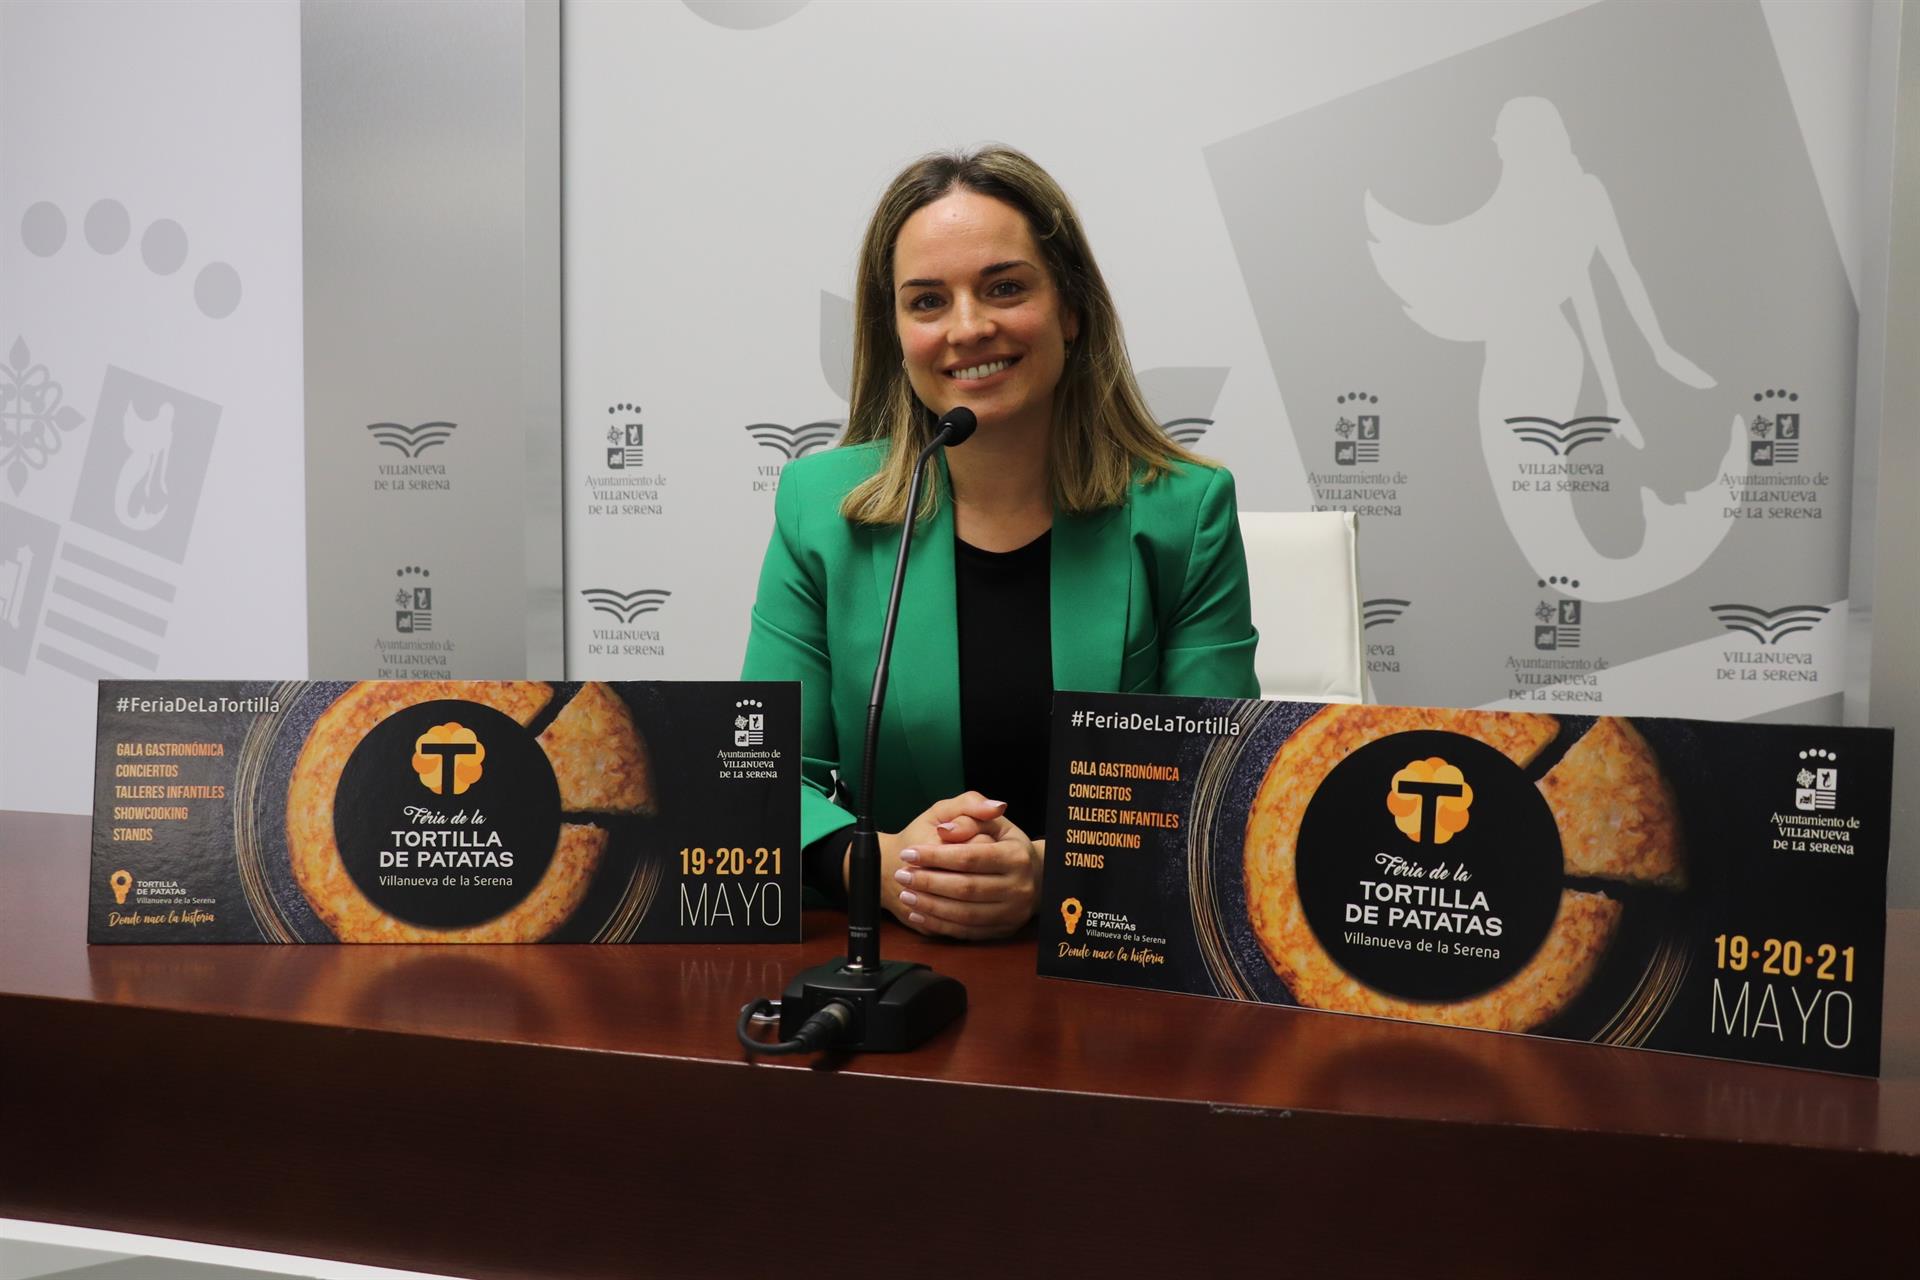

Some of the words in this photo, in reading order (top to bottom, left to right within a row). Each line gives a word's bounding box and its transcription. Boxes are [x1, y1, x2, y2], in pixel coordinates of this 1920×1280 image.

[585, 474, 653, 490] Ayuntamiento
[654, 473, 667, 486] de
[1307, 471, 1391, 488] Ayuntamiento
[1392, 470, 1409, 485] de
[1719, 472, 1810, 489] Ayuntamiento
[1812, 472, 1829, 486] de
[375, 638, 441, 652] Ayuntamiento
[443, 640, 456, 651] de
[1367, 660, 1400, 672] RENA
[1505, 655, 1591, 672] Ayuntamiento
[1593, 657, 1609, 670] de
[116, 697, 280, 713] #FeriaDeLaTortilla
[1071, 710, 1240, 736] #FeriaDeLaTortilla
[116, 743, 143, 756] GALA
[145, 741, 224, 756] GASTRONÓMICA
[717, 749, 770, 760] Ayuntamiento
[771, 749, 781, 758] de
[115, 764, 179, 778] CONCIERTOS
[1070, 760, 1097, 776] GALA
[1099, 762, 1180, 782] GASTRONÓMICA
[115, 785, 165, 799] TALLERES
[167, 785, 225, 799] INFANTILES
[1069, 783, 1132, 802] CONCIERTOS
[114, 806, 189, 820] SHOWCOOKING
[403, 805, 448, 825] Feria
[450, 809, 468, 825] de
[471, 809, 487, 825] la
[1067, 806, 1118, 824] TALLERES
[1119, 809, 1180, 829] INFANTILES
[1770, 812, 1844, 828] Ayuntamiento
[1846, 816, 1860, 829] de
[113, 828, 153, 841] STANDS
[391, 831, 503, 847] TORTILLA
[1066, 829, 1141, 849] SHOWCOOKING
[379, 851, 409, 868] DE
[417, 851, 514, 868] PATATAS
[1065, 852, 1105, 869] STANDS
[1375, 852, 1426, 878] Feria
[1429, 862, 1450, 880] de
[1453, 863, 1472, 882] la
[379, 875, 439, 886] Villanueva
[442, 875, 457, 886] de
[460, 875, 470, 886] la
[473, 875, 513, 886] Serena
[680, 882, 782, 927] MAYO
[1359, 881, 1490, 911] TORTILLA
[108, 911, 141, 927] Donde
[143, 915, 166, 924] nace
[168, 910, 179, 924] la
[181, 909, 215, 927] historia
[1086, 911, 1128, 922] TORTILLA
[1345, 904, 1379, 925] DE
[1388, 907, 1502, 937] PATATAS
[1100, 921, 1137, 932] PATATAS
[1086, 929, 1122, 940] Villanueva
[1123, 933, 1132, 941] de
[1133, 934, 1140, 942] la
[1142, 935, 1166, 945] Serena
[1058, 941, 1091, 959] Donde
[1092, 950, 1115, 960] nace
[1117, 946, 1129, 961] la
[1130, 947, 1165, 968] historia
[1344, 932, 1412, 950] Villanueva
[1416, 938, 1433, 952] de
[1438, 941, 1449, 954] la
[1454, 943, 1500, 960] Serena
[1711, 978, 1853, 1049] MAYO
